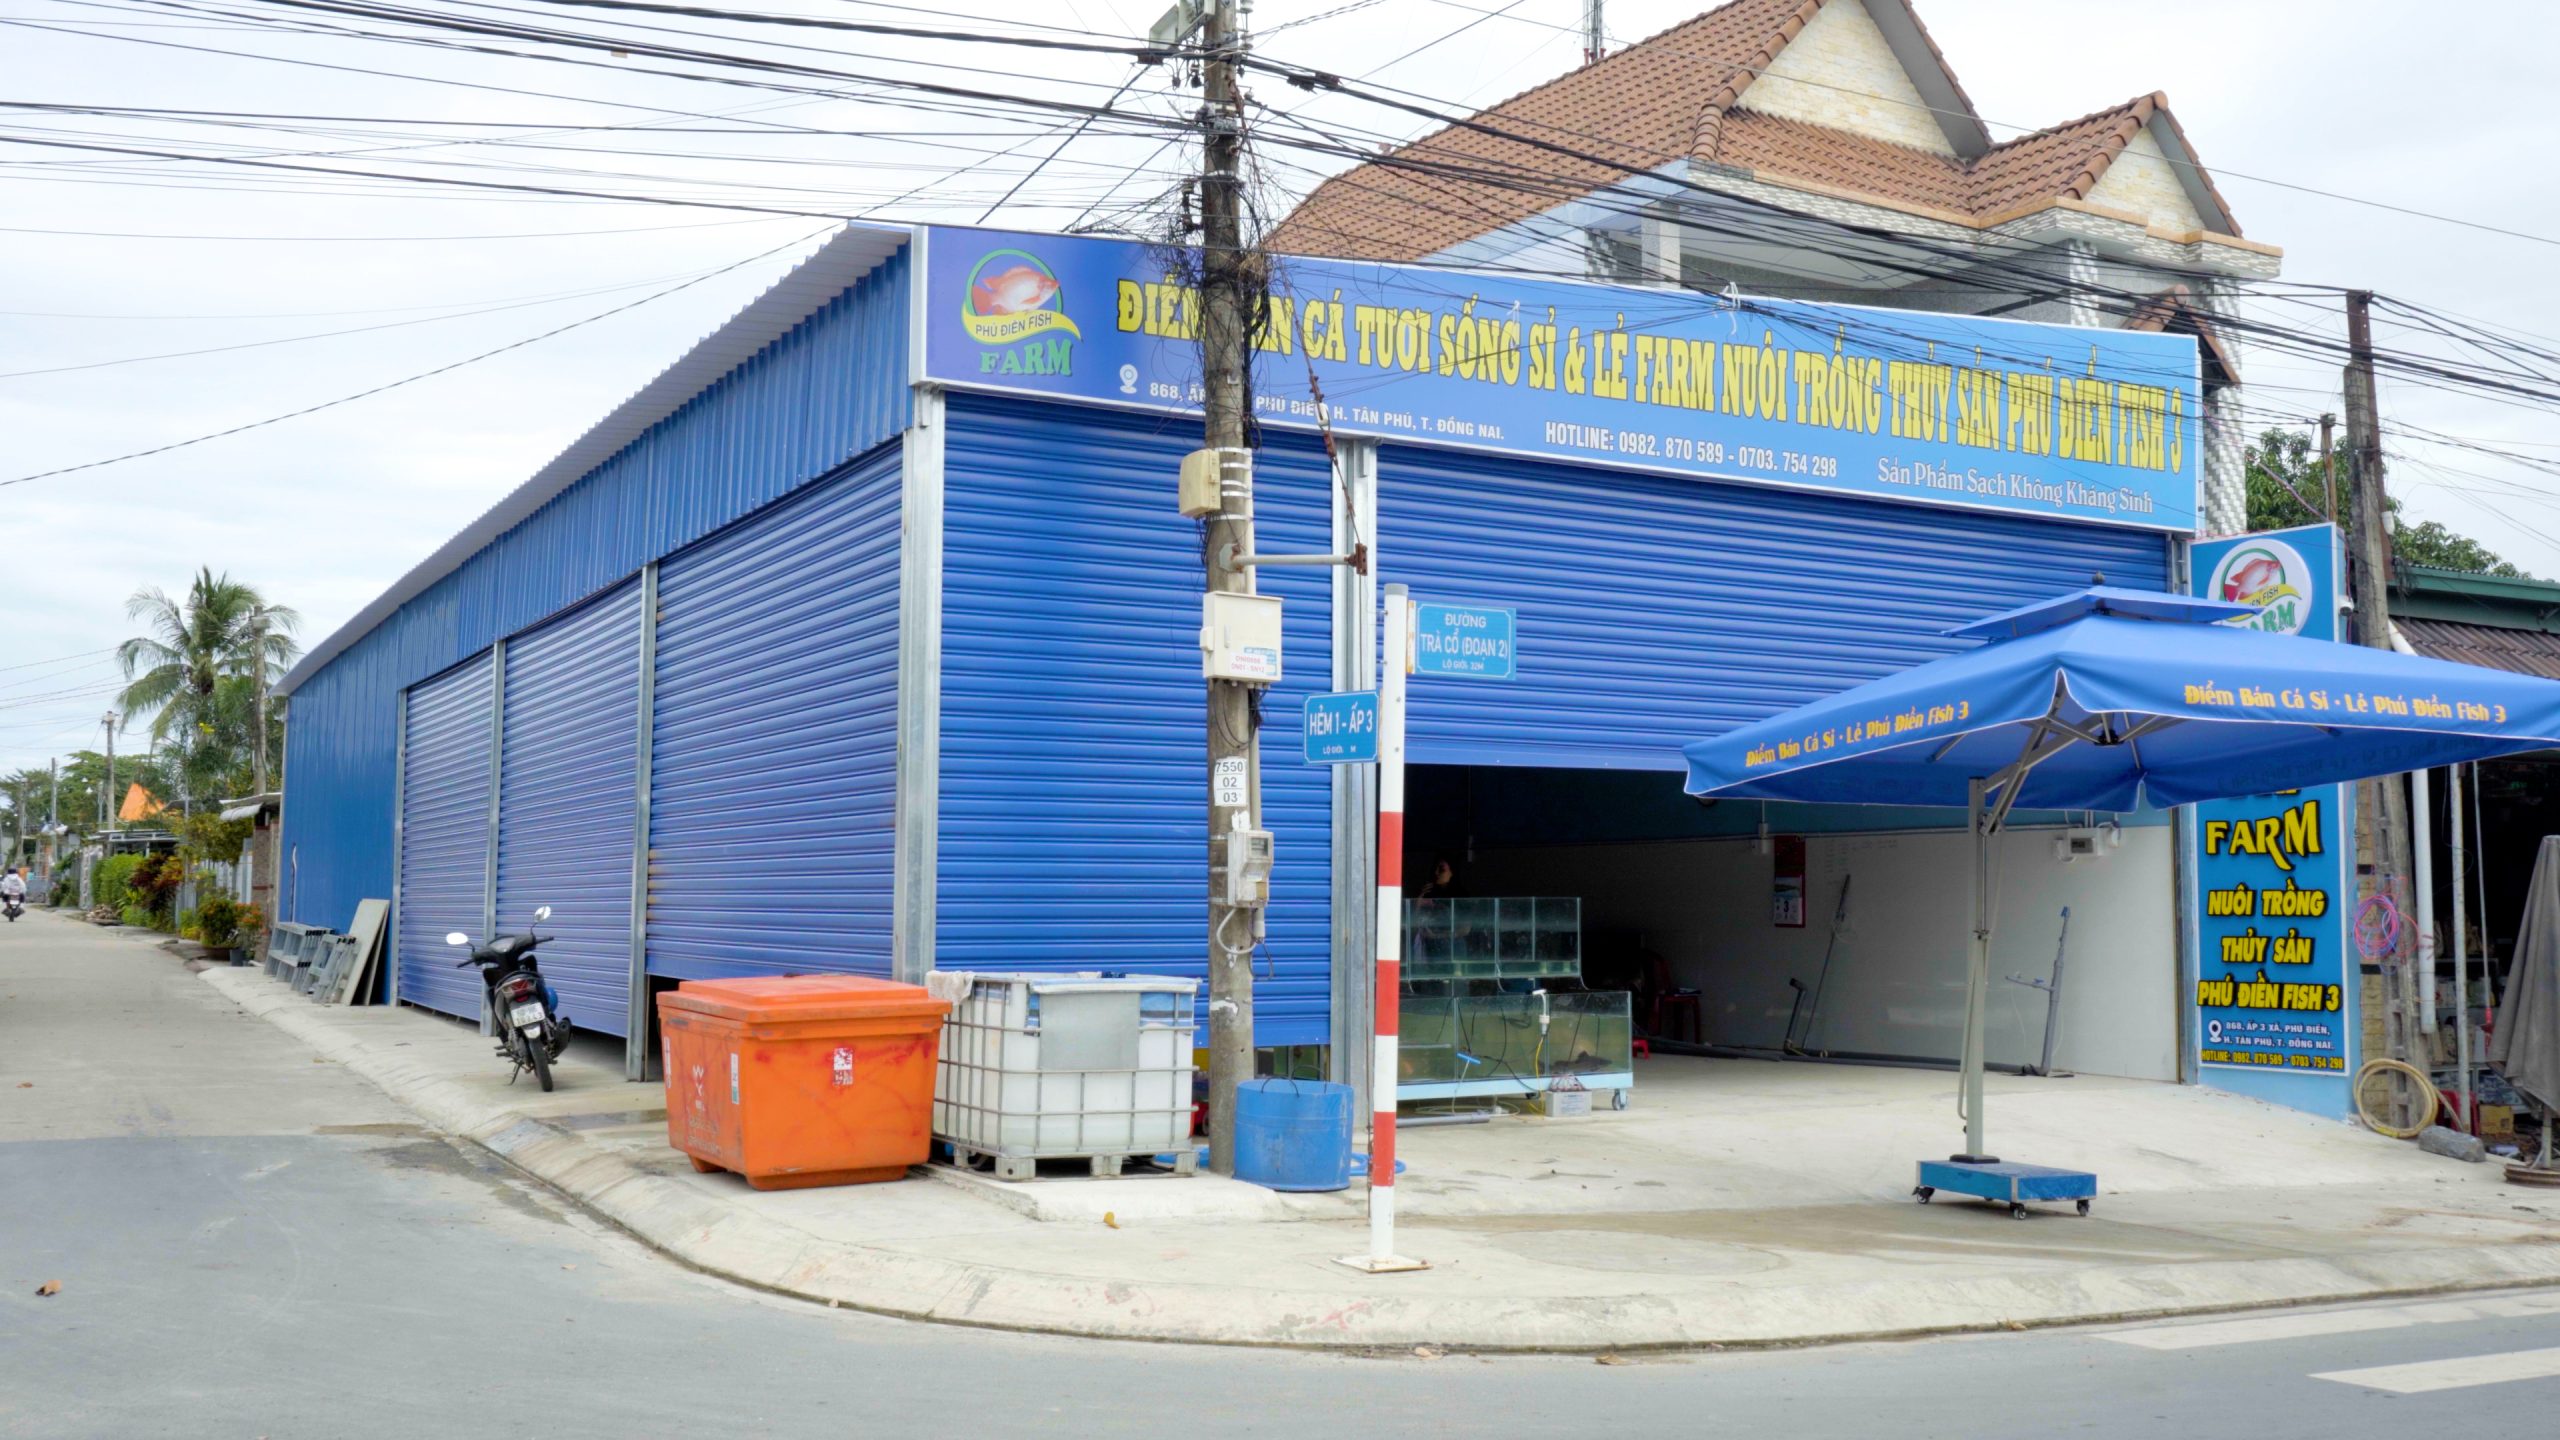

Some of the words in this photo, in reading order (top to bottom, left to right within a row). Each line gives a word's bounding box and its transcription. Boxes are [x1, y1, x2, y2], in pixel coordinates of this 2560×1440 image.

[1028, 312, 1052, 328] FISH
[980, 338, 1072, 377] FARM
[1303, 289, 1347, 362] CÁ
[1439, 293, 1520, 386] SỐNG
[1528, 305, 1557, 391] SỈ
[1563, 326, 1585, 395] &
[1592, 312, 1629, 400] LẺ
[1634, 334, 1716, 413] FARM
[1721, 329, 1789, 421] NUÔI
[1888, 340, 1952, 443] THỦY
[1956, 344, 2002, 451] SẢN
[2006, 355, 2054, 457] PHÚ
[2117, 381, 2167, 472] FISH
[2169, 386, 2184, 475] 3
[1150, 382, 1184, 402] 868,
[1255, 395, 1286, 412] PHÚ
[1333, 406, 1348, 421] H.
[1352, 407, 1379, 425] TÂN
[1384, 411, 1417, 431] PHÚ,
[1420, 416, 1433, 431] T.
[1437, 416, 1474, 436] ĐỒNG
[1478, 423, 1505, 440] NAI.
[1545, 421, 1614, 451] HOTLINE:
[1618, 431, 1660, 457] 0982.
[1665, 437, 1693, 461] 870
[1697, 441, 1724, 464] 589
[1738, 446, 1778, 471] 0703.
[1782, 452, 1808, 475] 754
[1811, 456, 1837, 478] 298
[1878, 457, 1911, 484] Sản
[1914, 459, 1963, 491] Phẩm
[1967, 468, 2007, 499] Sạch
[2010, 474, 2063, 508] Không
[2066, 480, 2117, 513] Kháng
[2119, 486, 2153, 513] Sinh
[1445, 611, 1487, 628] ĐƯỜNG
[1420, 630, 1442, 653] TRÀ
[1445, 628, 1459, 654] CỔ
[1462, 636, 1496, 661] (ĐOẠN
[1498, 639, 1508, 659] 2)
[1309, 704, 1333, 736] HẺM
[1335, 711, 1340, 735] 1
[1348, 701, 1365, 734] ẤP
[1366, 709, 1373, 733] 3
[2184, 679, 2235, 707] Điểm
[2239, 685, 2276, 708] Bán
[2280, 687, 2305, 710] Cá
[2373, 695, 2408, 716] Phú
[2456, 702, 2490, 722] Fish
[2494, 705, 2507, 723] 3
[1745, 741, 1775, 768] Điểm
[1778, 737, 1801, 761] Bán
[1804, 731, 1819, 753] Cá
[1866, 714, 1890, 740] Phú
[1928, 703, 1955, 725] Fish
[1957, 700, 1969, 720] 3
[1215, 761, 1244, 773] 7550
[1222, 777, 1237, 788] 02
[1222, 792, 1238, 803] 03
[2205, 800, 2322, 871] FARM
[2207, 882, 2254, 917] NUÔI
[2261, 877, 2327, 917] TRỒNG
[2221, 927, 2269, 963] THỦY
[2273, 928, 2314, 964] SẢN
[2198, 974, 2234, 1006] PHÚ
[2237, 969, 2280, 1008] ĐIỀN
[2282, 983, 2323, 1011] FISH
[2325, 984, 2341, 1011] 3
[2201, 1050, 2230, 1063] HOTLINE:
